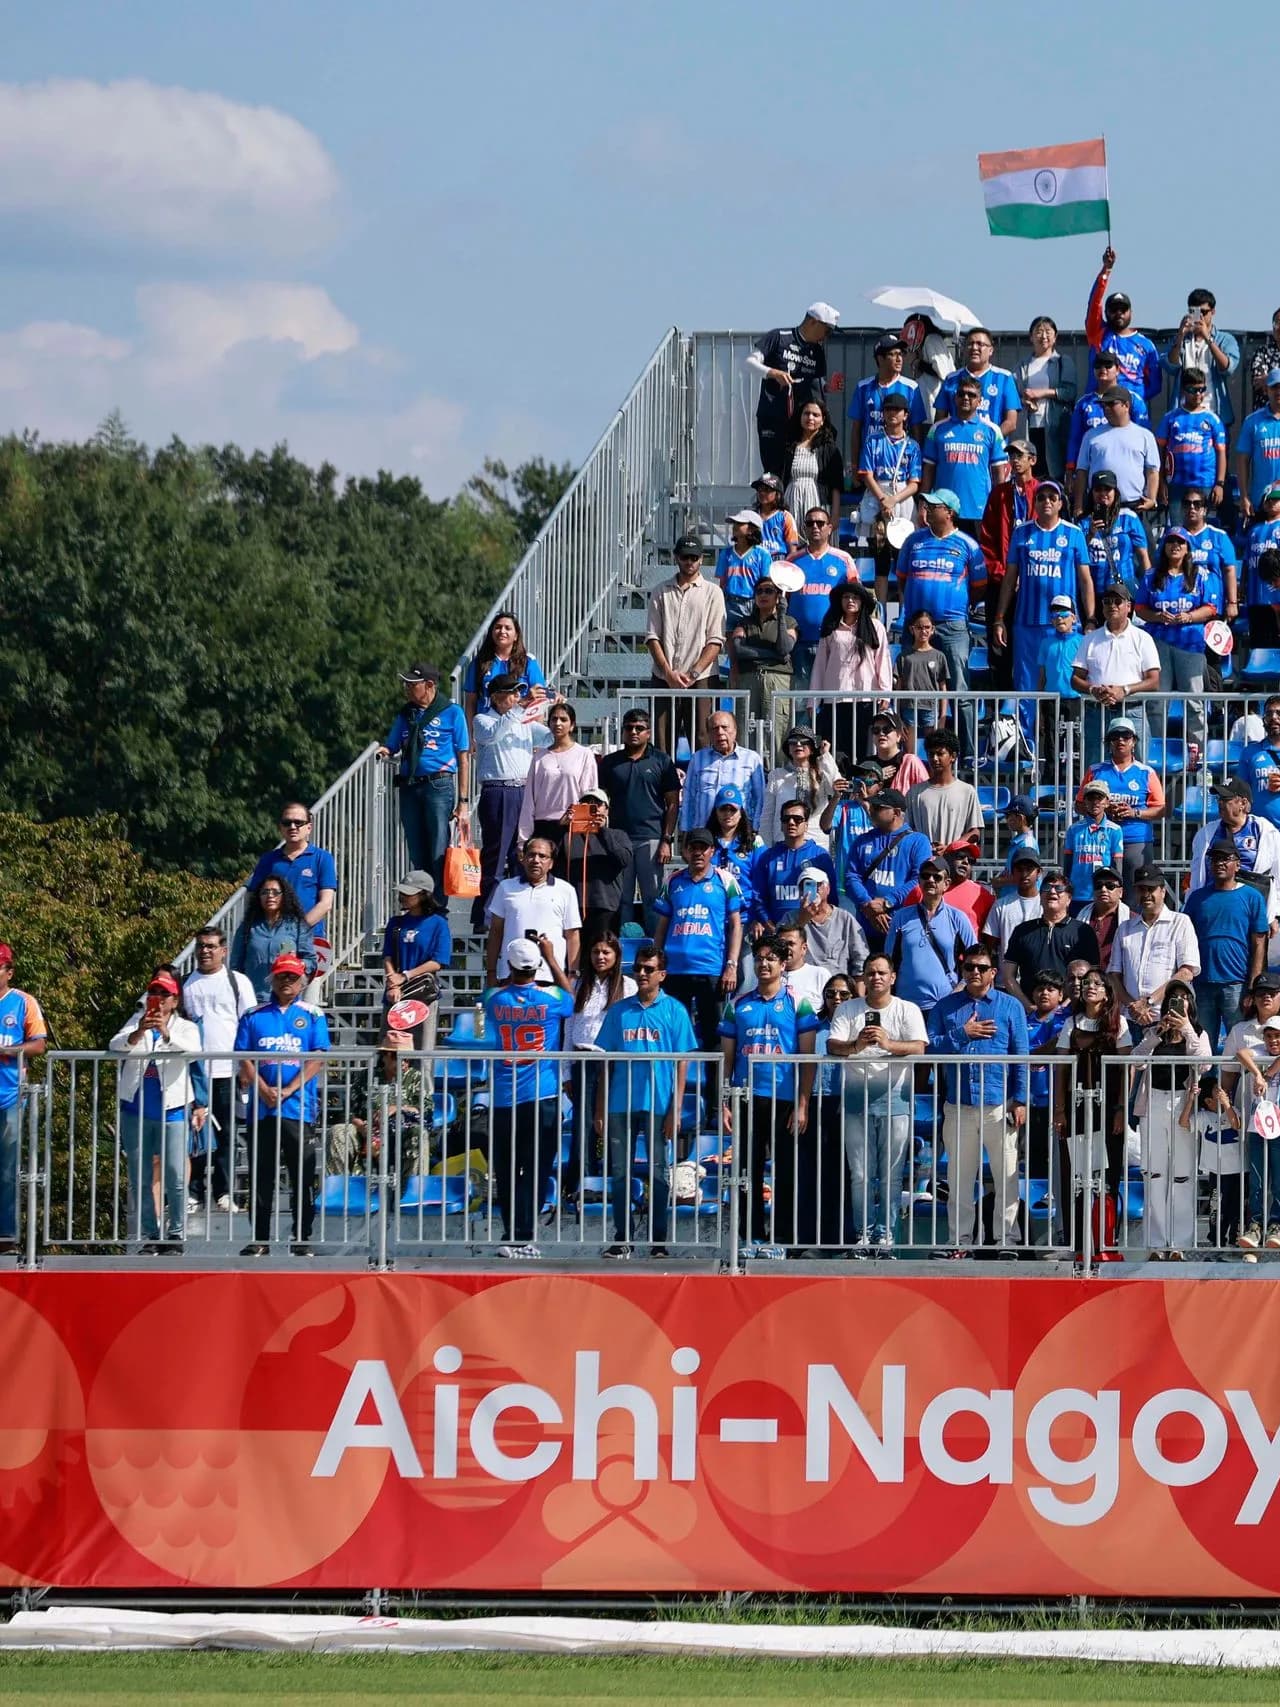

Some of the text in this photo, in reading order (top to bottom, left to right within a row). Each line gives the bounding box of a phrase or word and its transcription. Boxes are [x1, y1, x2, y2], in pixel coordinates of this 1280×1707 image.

[1028, 547, 1062, 561] apollo
[911, 558, 954, 571] apollo
[1027, 563, 1062, 579] INDIA
[1154, 597, 1193, 611] apollo
[678, 904, 709, 918] apollo
[672, 922, 713, 937] INDIA
[493, 1004, 548, 1022] VIRAT
[258, 1033, 302, 1050] apollo
[622, 1027, 661, 1042] INDIA
[500, 1023, 545, 1066] 18
